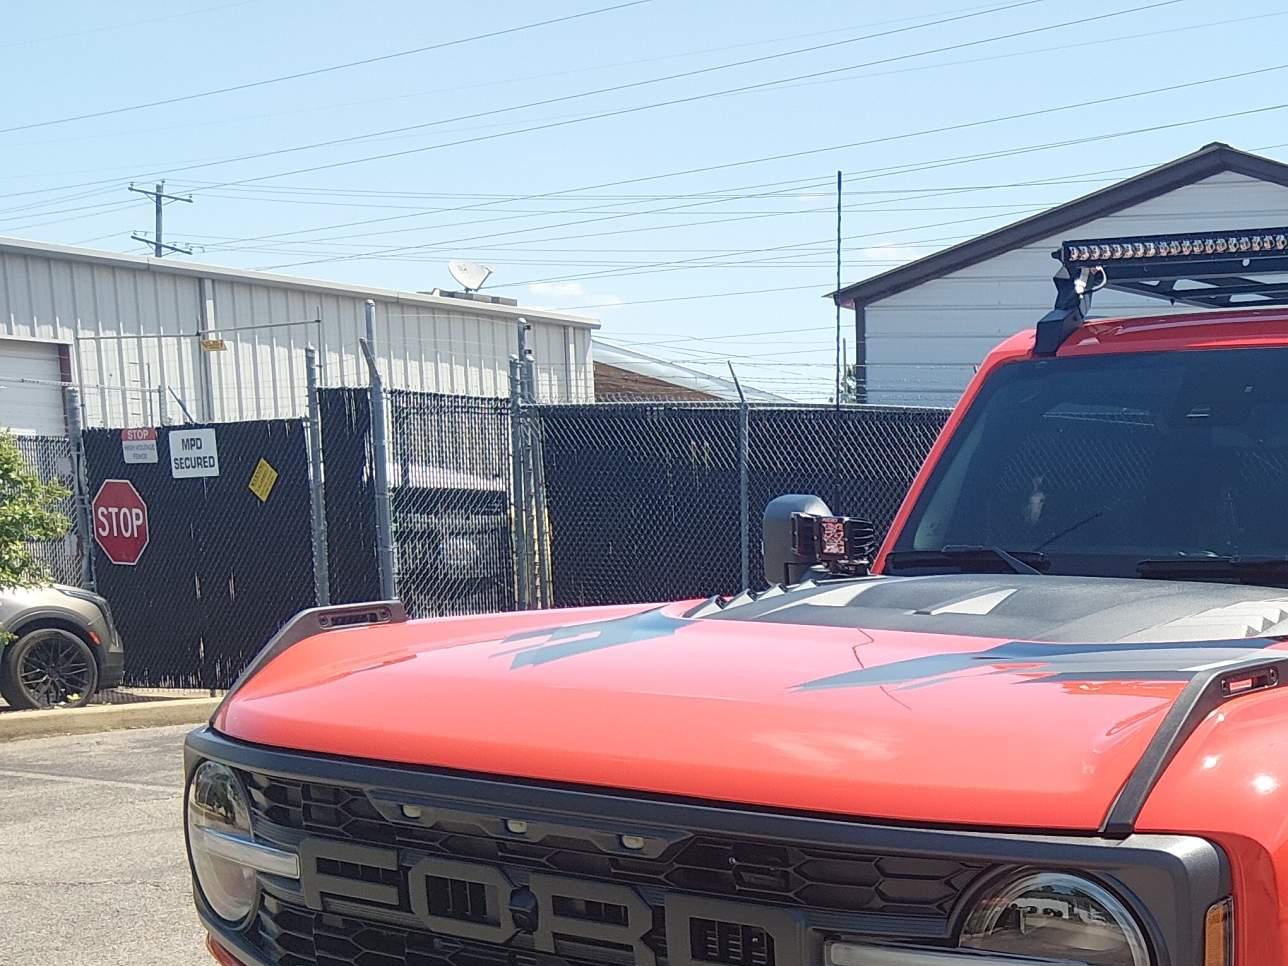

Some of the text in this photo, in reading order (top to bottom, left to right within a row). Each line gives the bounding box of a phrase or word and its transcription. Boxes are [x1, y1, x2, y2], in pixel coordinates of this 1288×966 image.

[127, 429, 148, 440] STOP
[181, 438, 202, 451] MPD
[173, 456, 215, 469] SECURED
[97, 506, 144, 538] STOP
